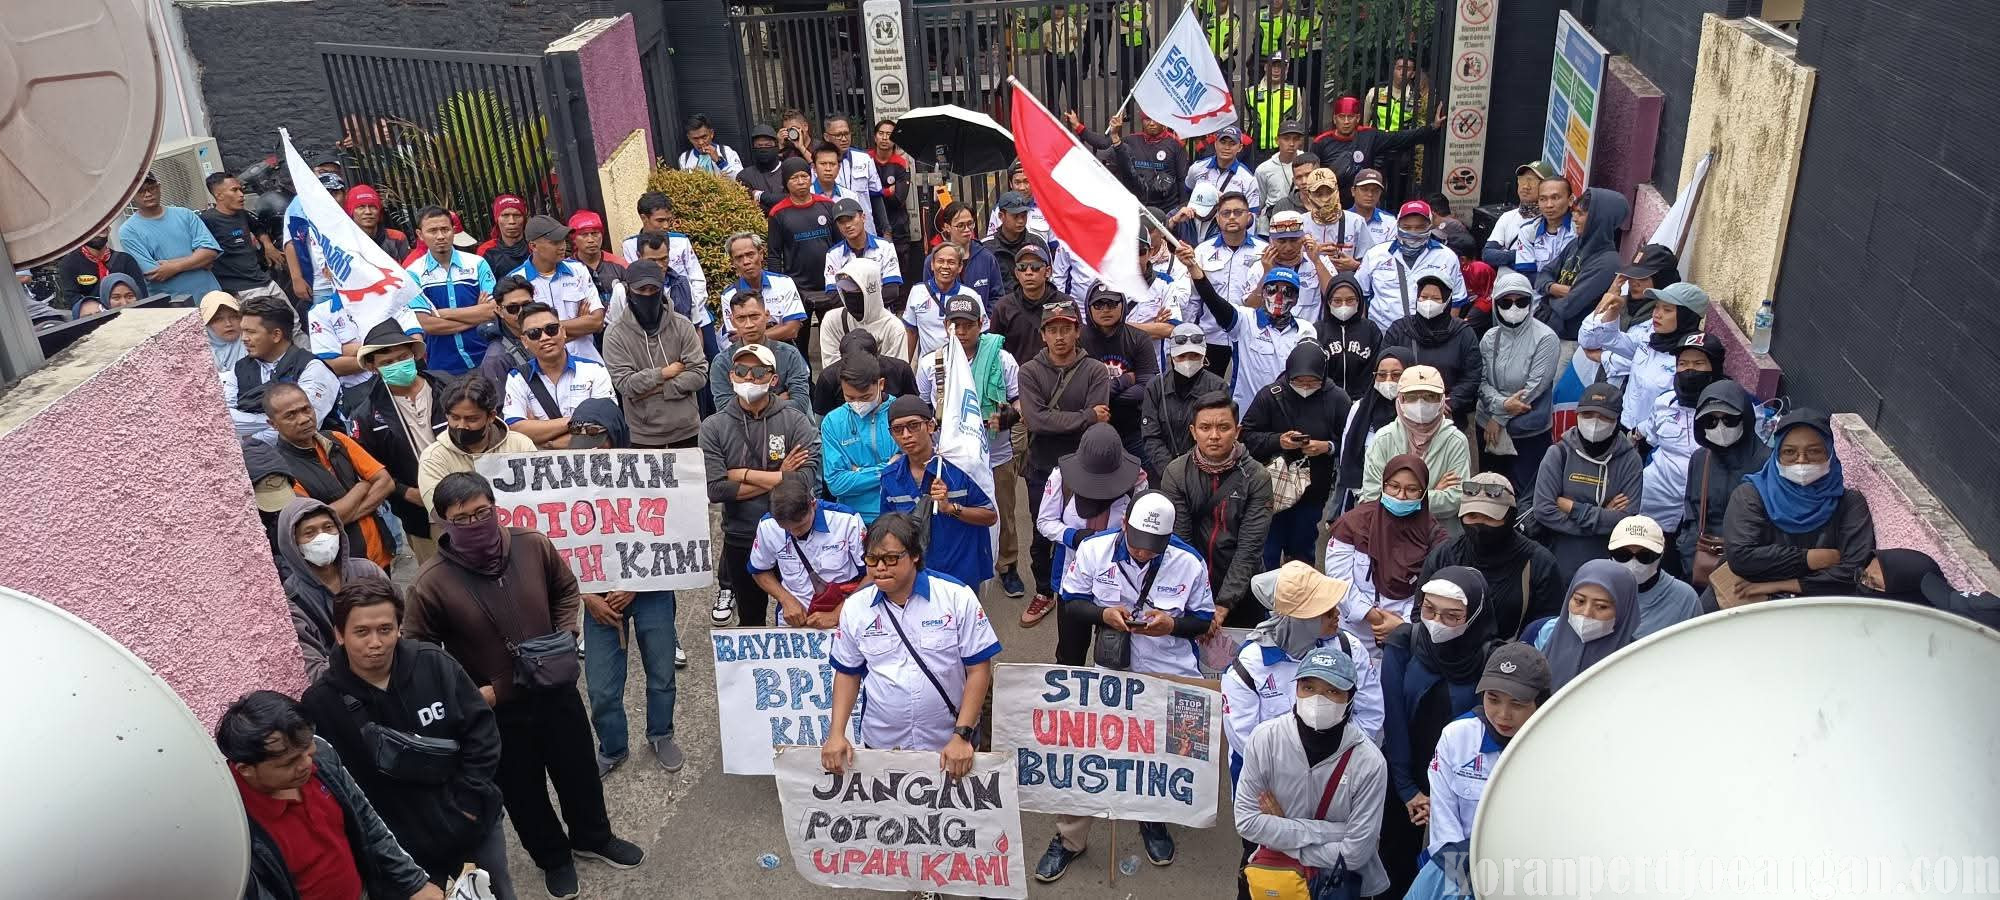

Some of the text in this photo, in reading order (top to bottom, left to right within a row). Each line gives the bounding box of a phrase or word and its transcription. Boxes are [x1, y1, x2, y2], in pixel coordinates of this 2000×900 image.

[1161, 44, 1208, 111] FSPMI
[493, 452, 679, 493] JANGAN
[615, 539, 712, 579] KAMI
[713, 632, 834, 662] BAYARK
[753, 664, 862, 711] BPJ
[1041, 669, 1145, 711] STOP
[1178, 699, 1202, 708] STOP
[416, 701, 446, 727] DG
[1032, 708, 1156, 754] UNION
[811, 769, 1004, 811] JANGAN
[1018, 747, 1195, 806] BUSTING
[800, 808, 977, 850] POTONG
[812, 833, 1010, 887] UPAH KAMI
